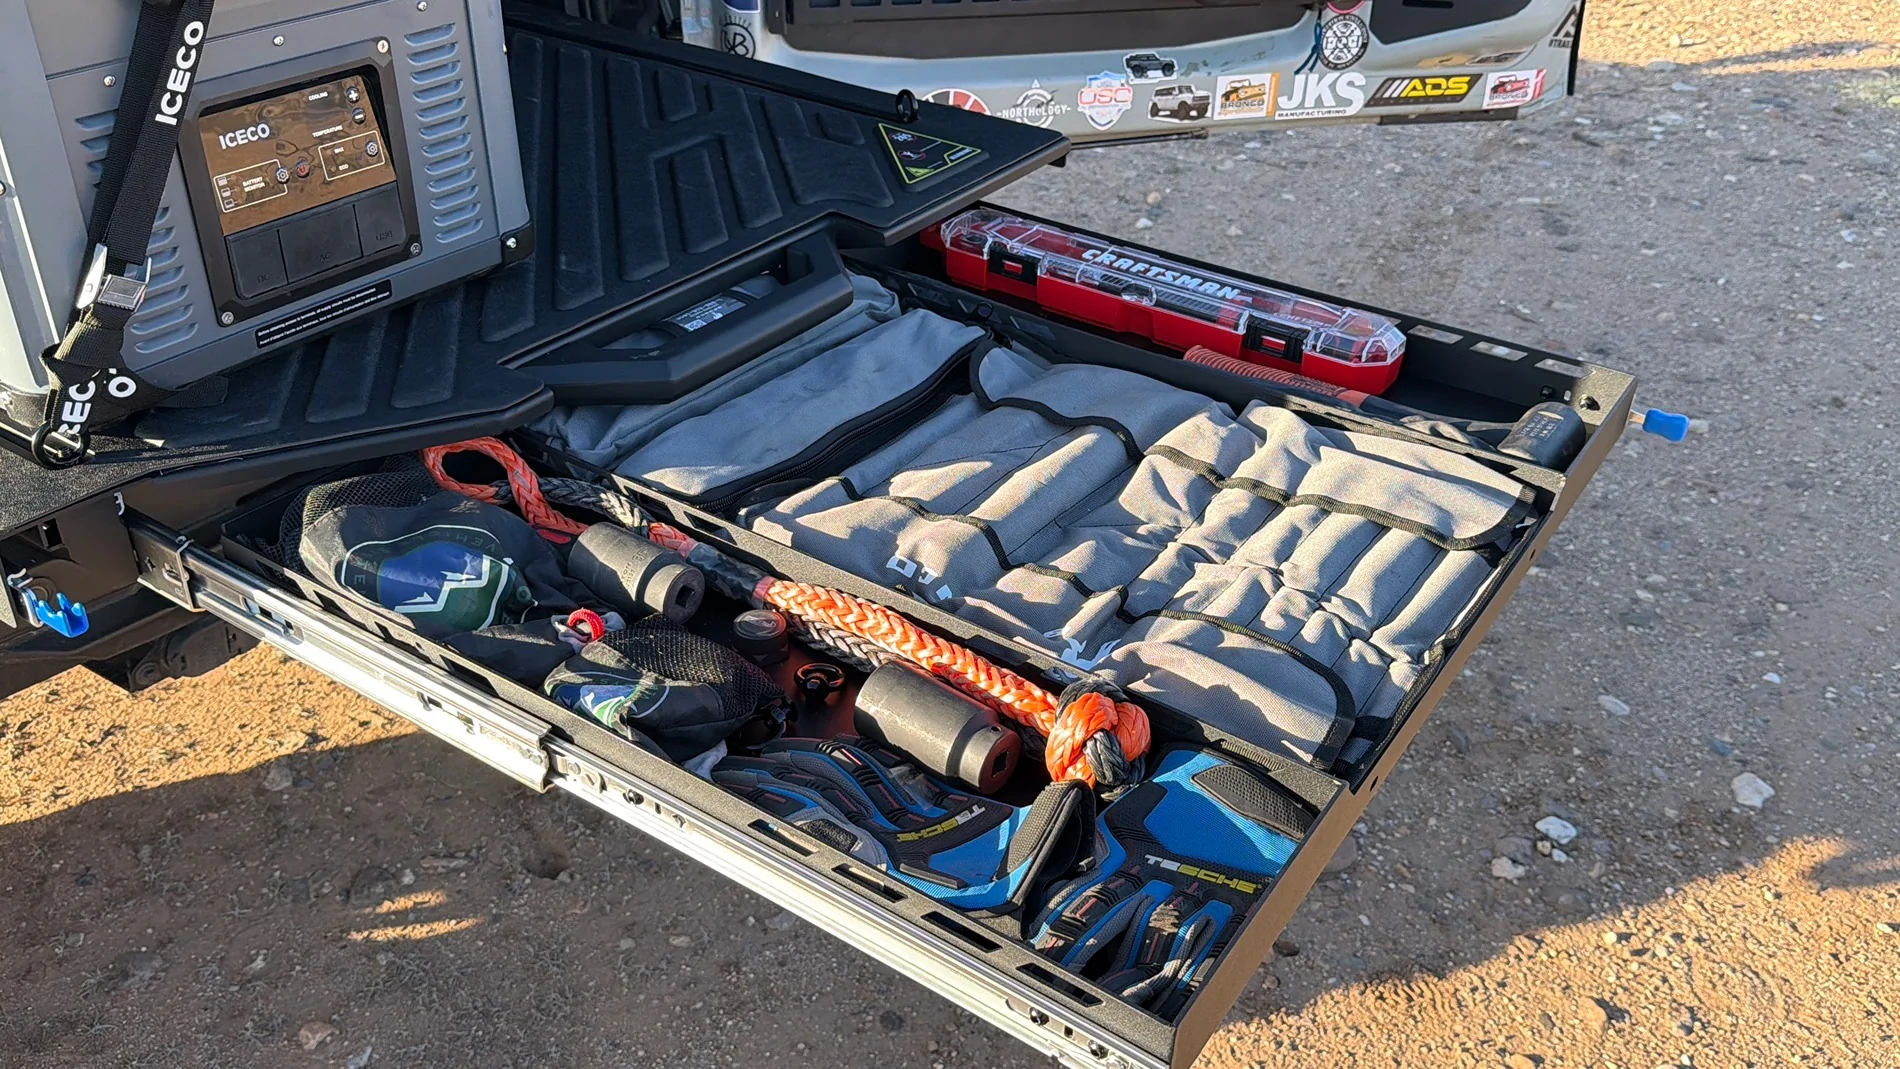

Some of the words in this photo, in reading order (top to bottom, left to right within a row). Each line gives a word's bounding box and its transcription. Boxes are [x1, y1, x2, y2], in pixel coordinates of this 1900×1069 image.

[155, 21, 204, 125] ICECO
[1278, 72, 1366, 112] JKS
[1400, 76, 1471, 98] ADS
[308, 92, 329, 101] COOLING
[1220, 100, 1264, 109] BRONCO
[1278, 109, 1347, 118] MANUFACTURING
[219, 123, 270, 150] ICECO
[312, 125, 343, 138] TEMPERATURE
[242, 176, 263, 187] BATTERY
[1081, 249, 1241, 300] CRAFTSMAN
